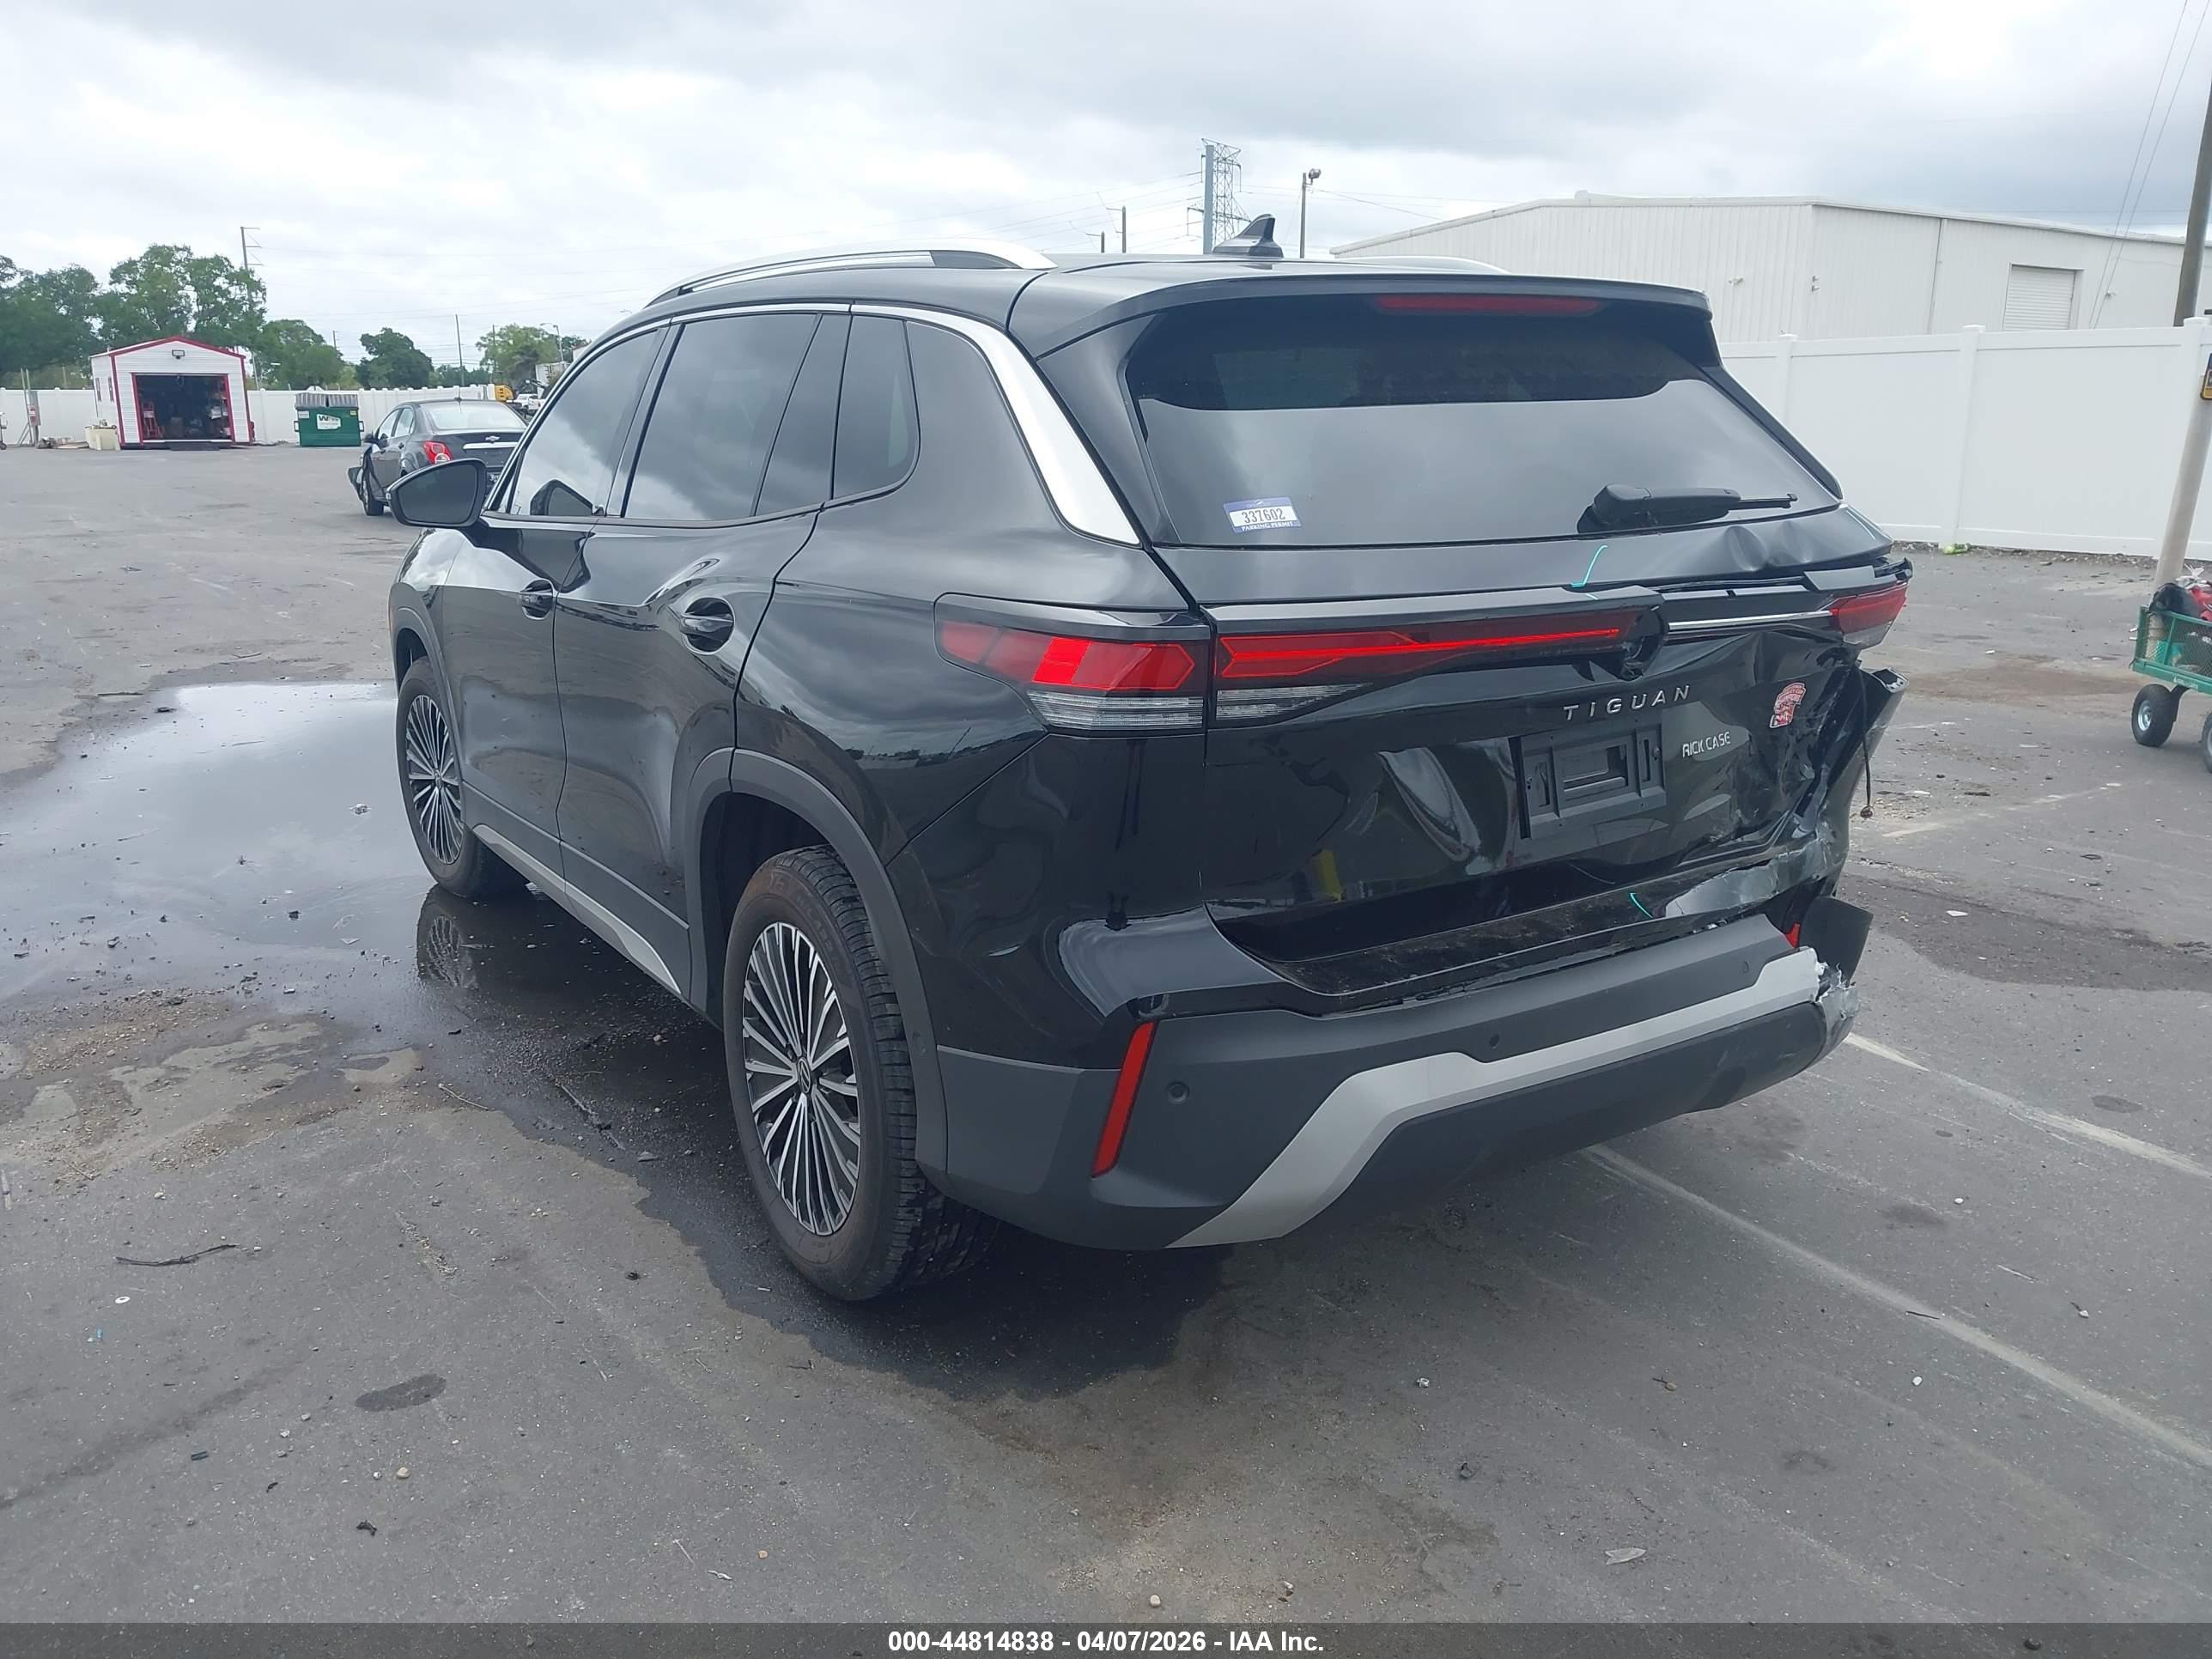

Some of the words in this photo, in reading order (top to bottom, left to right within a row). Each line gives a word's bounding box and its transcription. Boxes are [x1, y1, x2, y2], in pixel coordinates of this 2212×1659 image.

[1242, 508, 1285, 523] 337602
[1242, 522, 1270, 532] PARKING
[1563, 684, 1690, 720] TIGUAN
[1682, 738, 1705, 758] RICK
[1705, 731, 1731, 750] CASE
